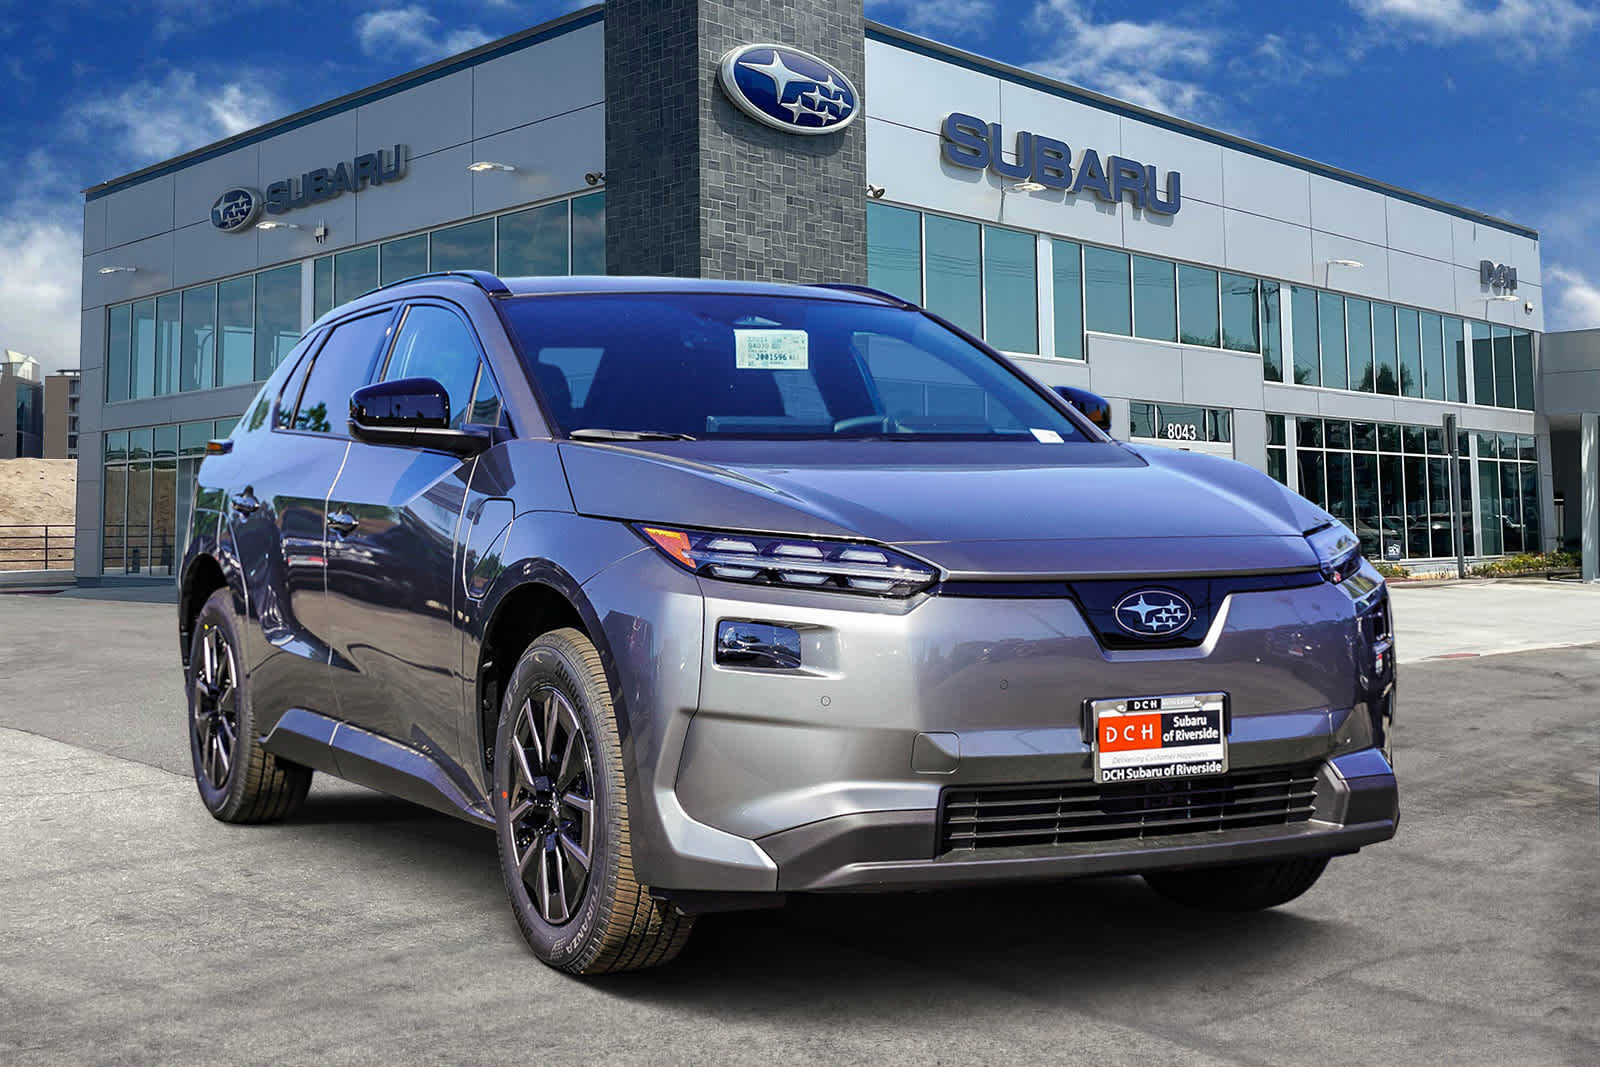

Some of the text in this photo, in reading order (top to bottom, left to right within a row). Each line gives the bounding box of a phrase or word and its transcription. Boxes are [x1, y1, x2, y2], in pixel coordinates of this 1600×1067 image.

[942, 112, 1181, 215] SUBARU
[266, 144, 407, 215] SUBARU
[1167, 423, 1196, 440] 8043
[1133, 700, 1158, 710] DCH
[1173, 715, 1208, 728] Subaru
[1105, 723, 1154, 744] DCH
[1162, 726, 1219, 742] of Riverside
[1102, 761, 1222, 781] DCH Subaru of Riverside
